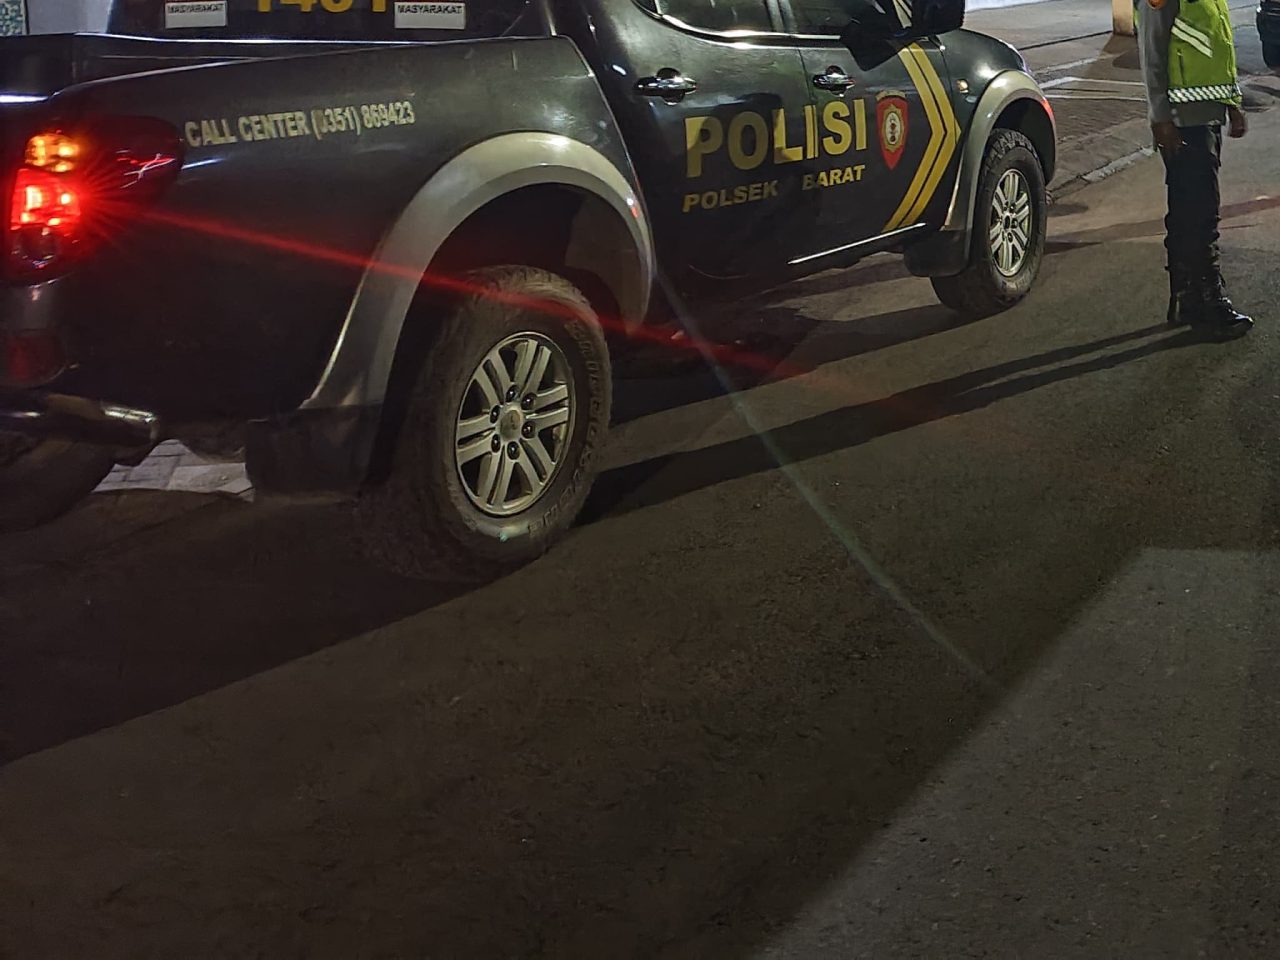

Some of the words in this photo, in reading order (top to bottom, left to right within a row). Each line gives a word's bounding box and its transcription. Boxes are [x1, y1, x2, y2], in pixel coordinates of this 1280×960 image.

[397, 4, 463, 14] MASYARAKAT
[184, 119, 237, 147] CALL
[238, 110, 310, 141] CENTER
[684, 98, 868, 178] POLISI
[682, 179, 779, 213] POLSEK
[802, 164, 866, 190] BARAT
